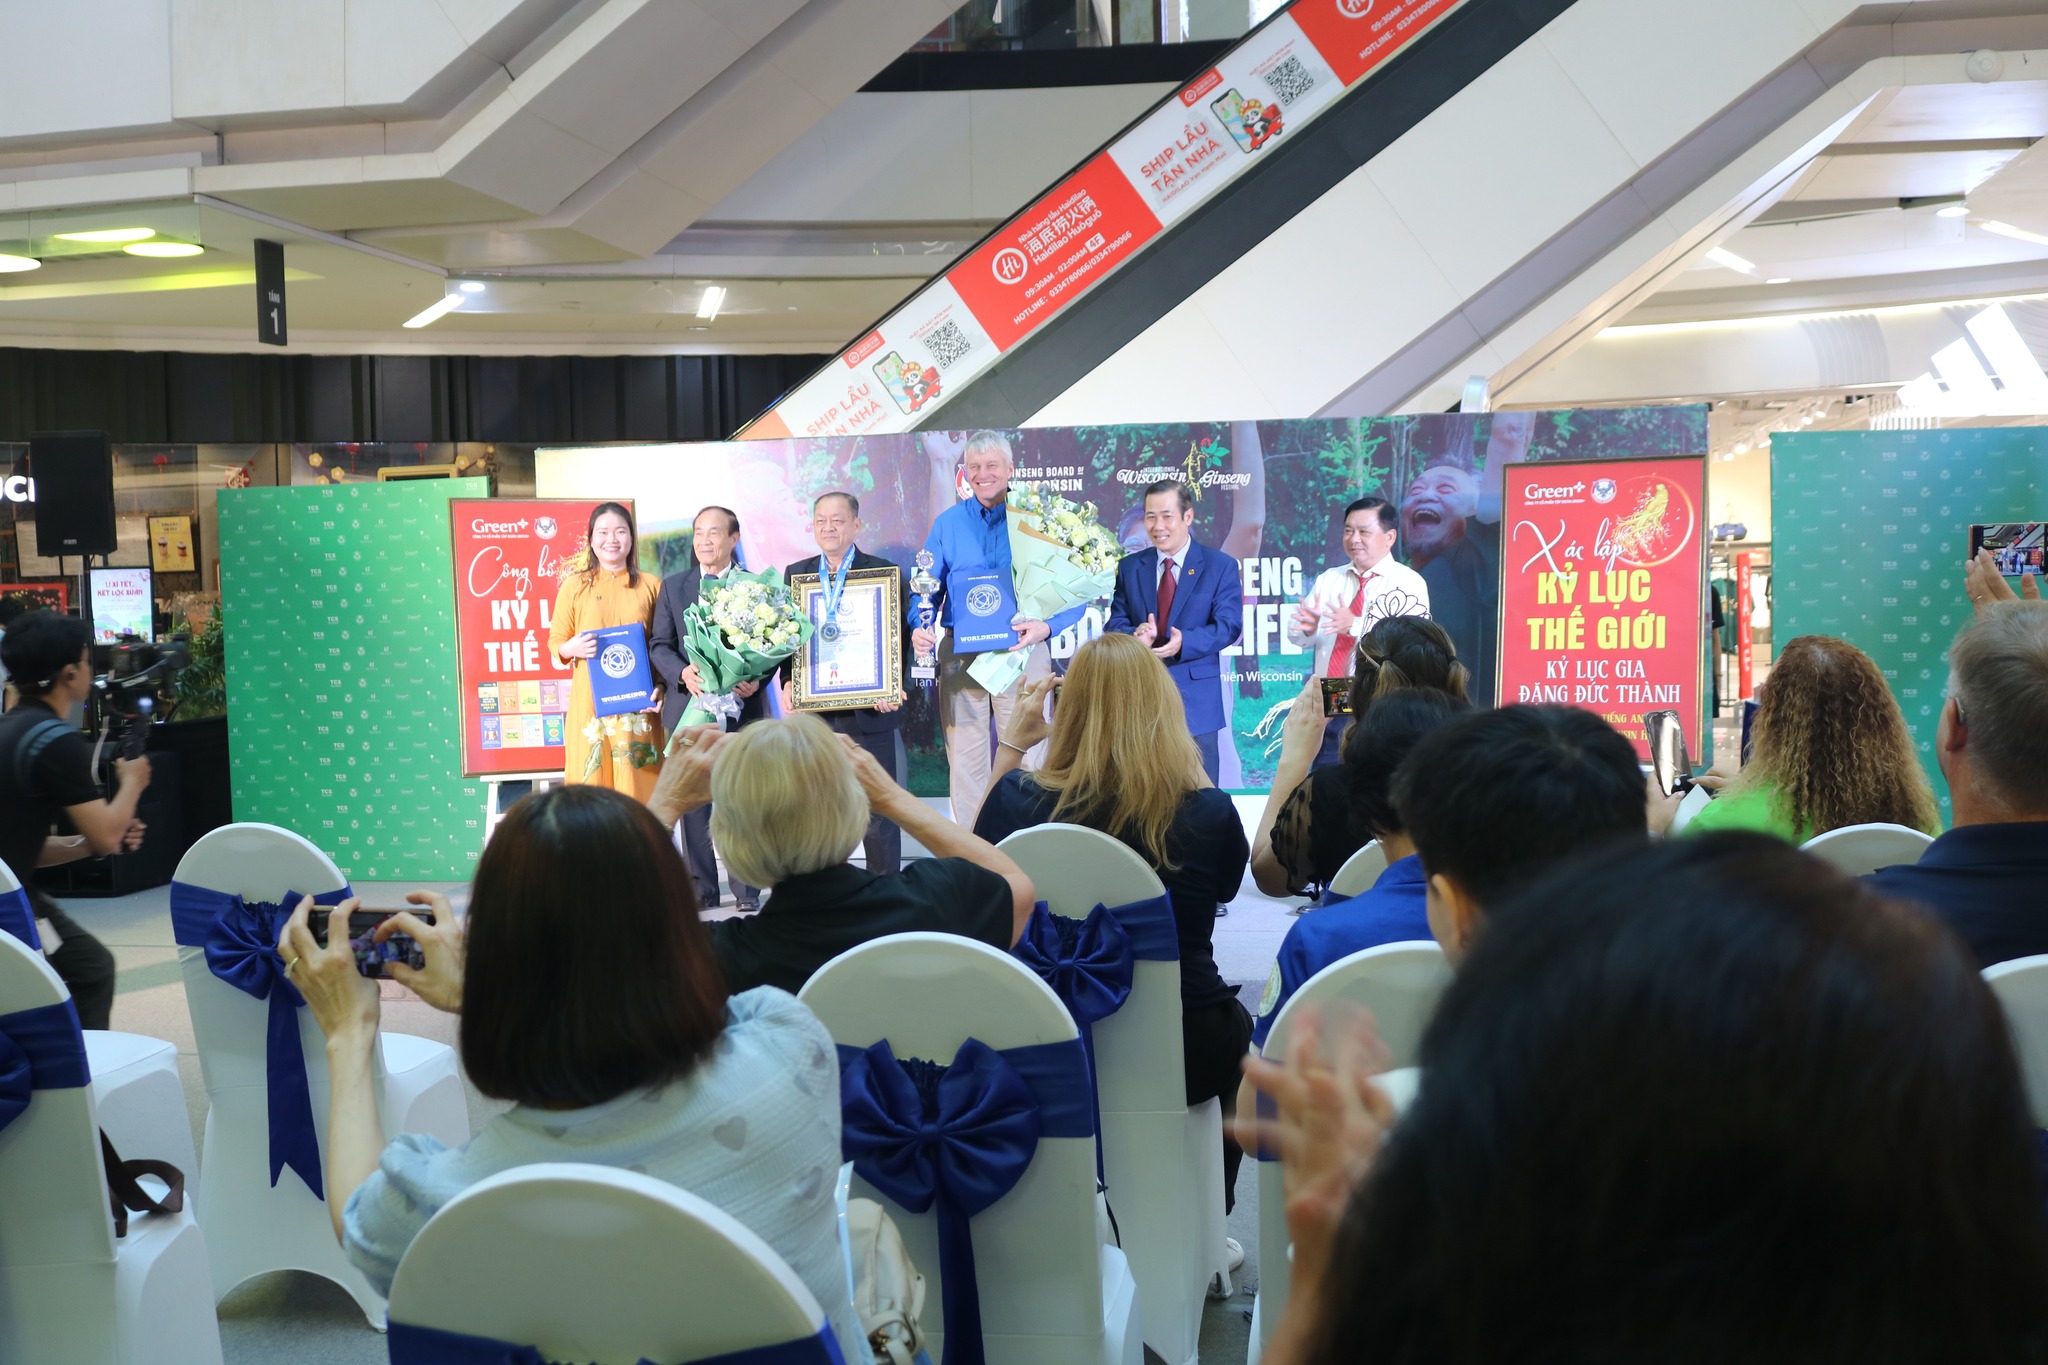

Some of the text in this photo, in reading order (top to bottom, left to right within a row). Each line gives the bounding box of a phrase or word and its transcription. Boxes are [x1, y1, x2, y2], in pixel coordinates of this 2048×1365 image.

[1141, 122, 1208, 178] SHIP LẨU
[1152, 137, 1220, 192] TẬN NHÀ
[1058, 188, 1087, 212] Haidilao
[1024, 194, 1098, 258] 海底捞火锅
[1024, 271, 1056, 298] 09:30AM
[1058, 246, 1088, 274] 02:00AM
[1088, 234, 1102, 250] 4F
[1032, 235, 1069, 266] Haidilao
[270, 308, 278, 335] 1
[806, 407, 838, 437] SHIP
[840, 383, 870, 412] LẨU
[848, 398, 882, 428] NHÀ
[1012, 468, 1043, 478] INSENG
[1046, 466, 1074, 477] BOARD
[1200, 470, 1251, 487] Ginseng
[468, 544, 556, 600] Công bố
[1537, 562, 1651, 610] KỶ LỤC
[960, 632, 1008, 642] WORLDKINGS
[1526, 604, 1666, 651] THẾ GIỚI
[484, 630, 540, 673] THẾ
[1246, 670, 1302, 682] Wisconsin
[1546, 655, 1646, 682] KỶ LỤC GIA
[1518, 681, 1681, 706] ĐẶNG ĐỨC THÀNH
